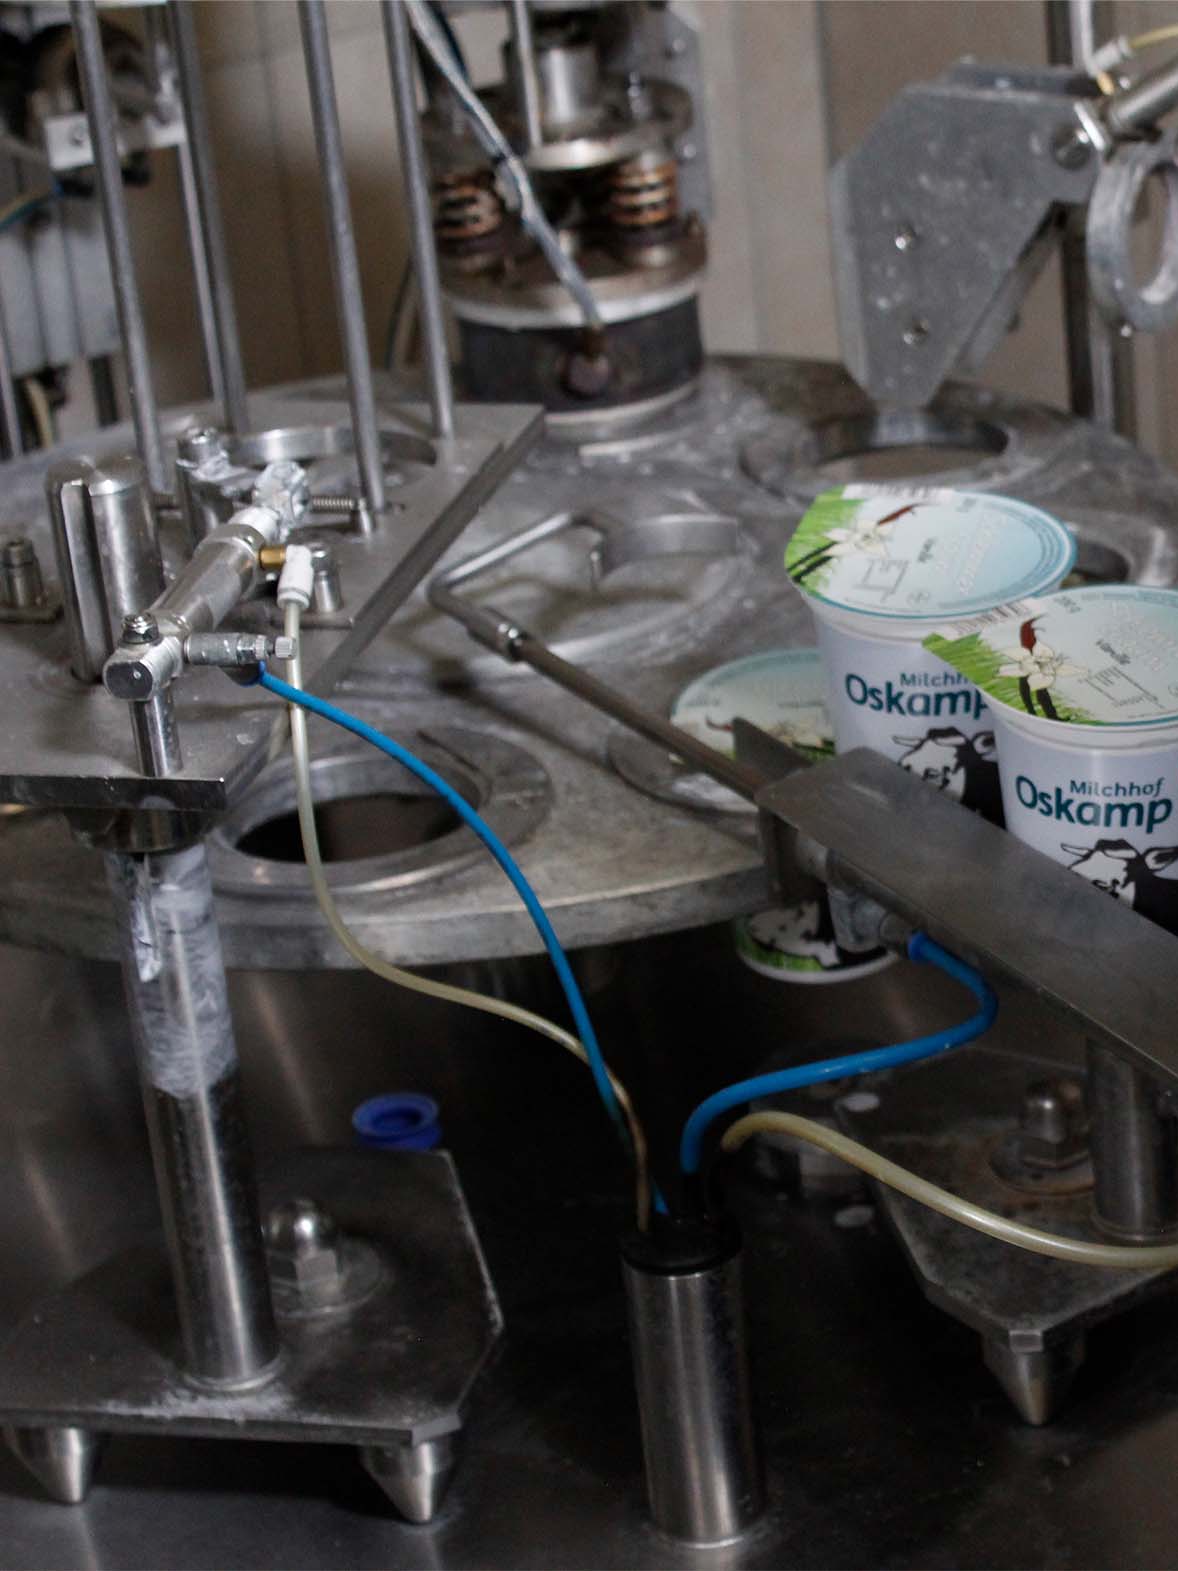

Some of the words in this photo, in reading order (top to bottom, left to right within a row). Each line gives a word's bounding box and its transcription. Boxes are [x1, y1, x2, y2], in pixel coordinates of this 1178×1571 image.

[899, 671, 969, 688] Milchh
[1069, 777, 1166, 797] Milchhof
[1015, 774, 1173, 834] Oskamp
